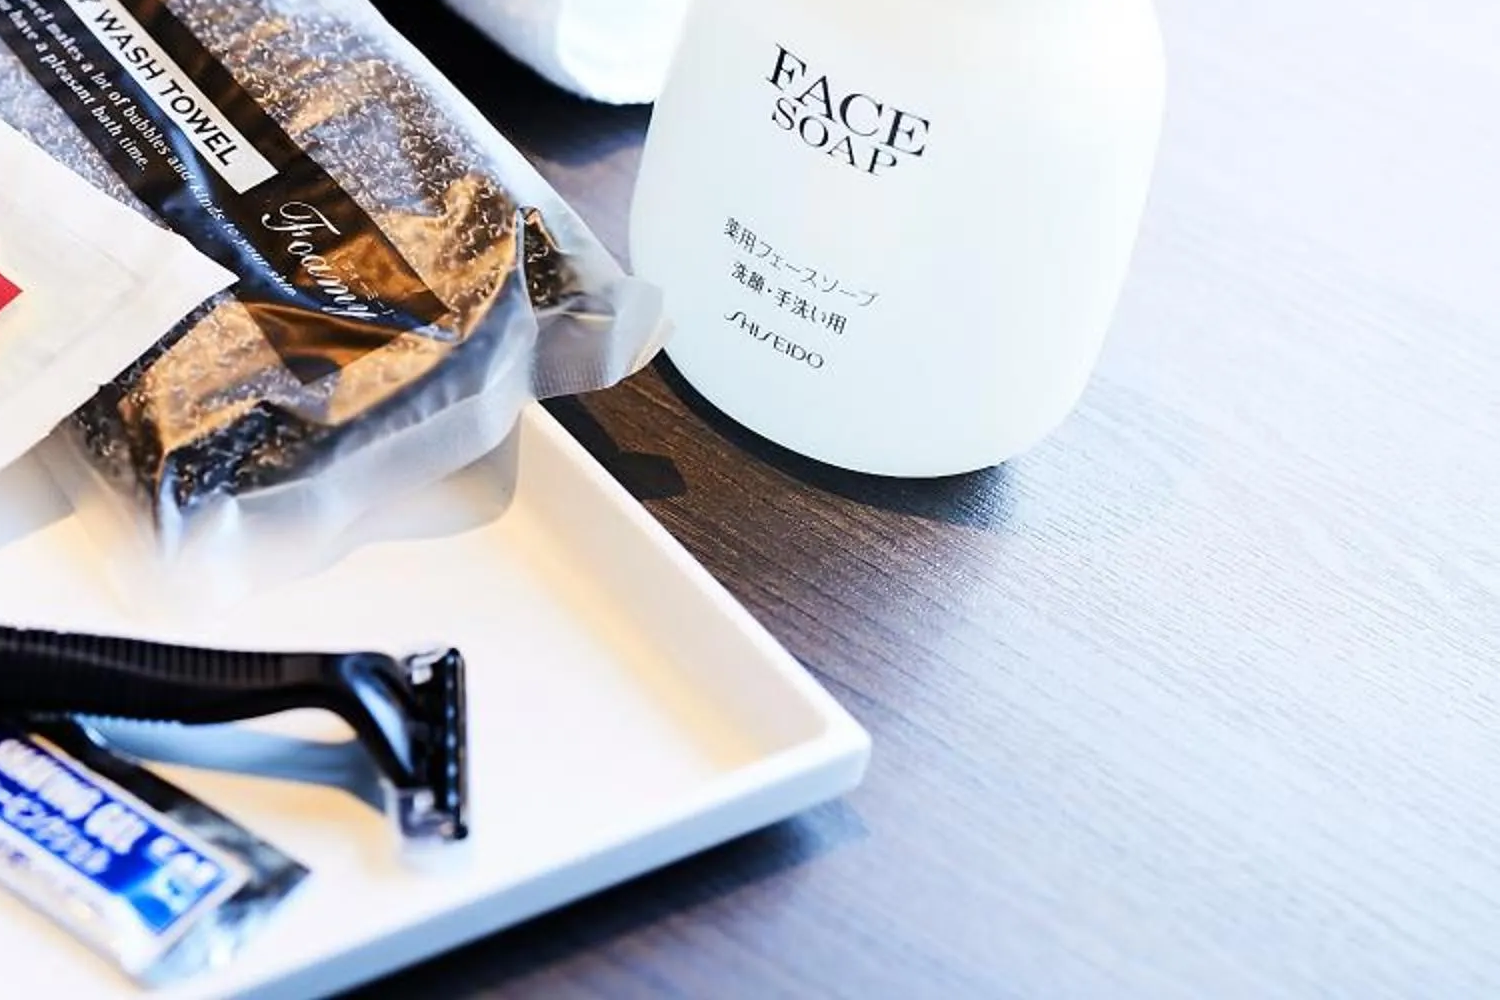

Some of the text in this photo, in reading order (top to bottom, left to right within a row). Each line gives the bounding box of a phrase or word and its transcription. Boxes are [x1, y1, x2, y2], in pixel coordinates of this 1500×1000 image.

[9, 10, 39, 40] have
[35, 42, 49, 53] a
[40, 53, 96, 105] pleasant
[94, 9, 165, 81] WASH
[160, 80, 237, 166] TOWEL
[765, 44, 929, 156] FACE
[46, 23, 84, 61] makes
[81, 62, 93, 73] a
[91, 72, 112, 90] lot
[108, 91, 131, 107] of
[123, 105, 171, 155] bubbles
[167, 155, 196, 181] and
[232, 238, 269, 268] your
[91, 106, 123, 137] bath
[771, 97, 897, 175] SOAP
[119, 138, 148, 171] time.
[261, 202, 377, 318] Foamy
[724, 310, 824, 369] SHISEIDO
